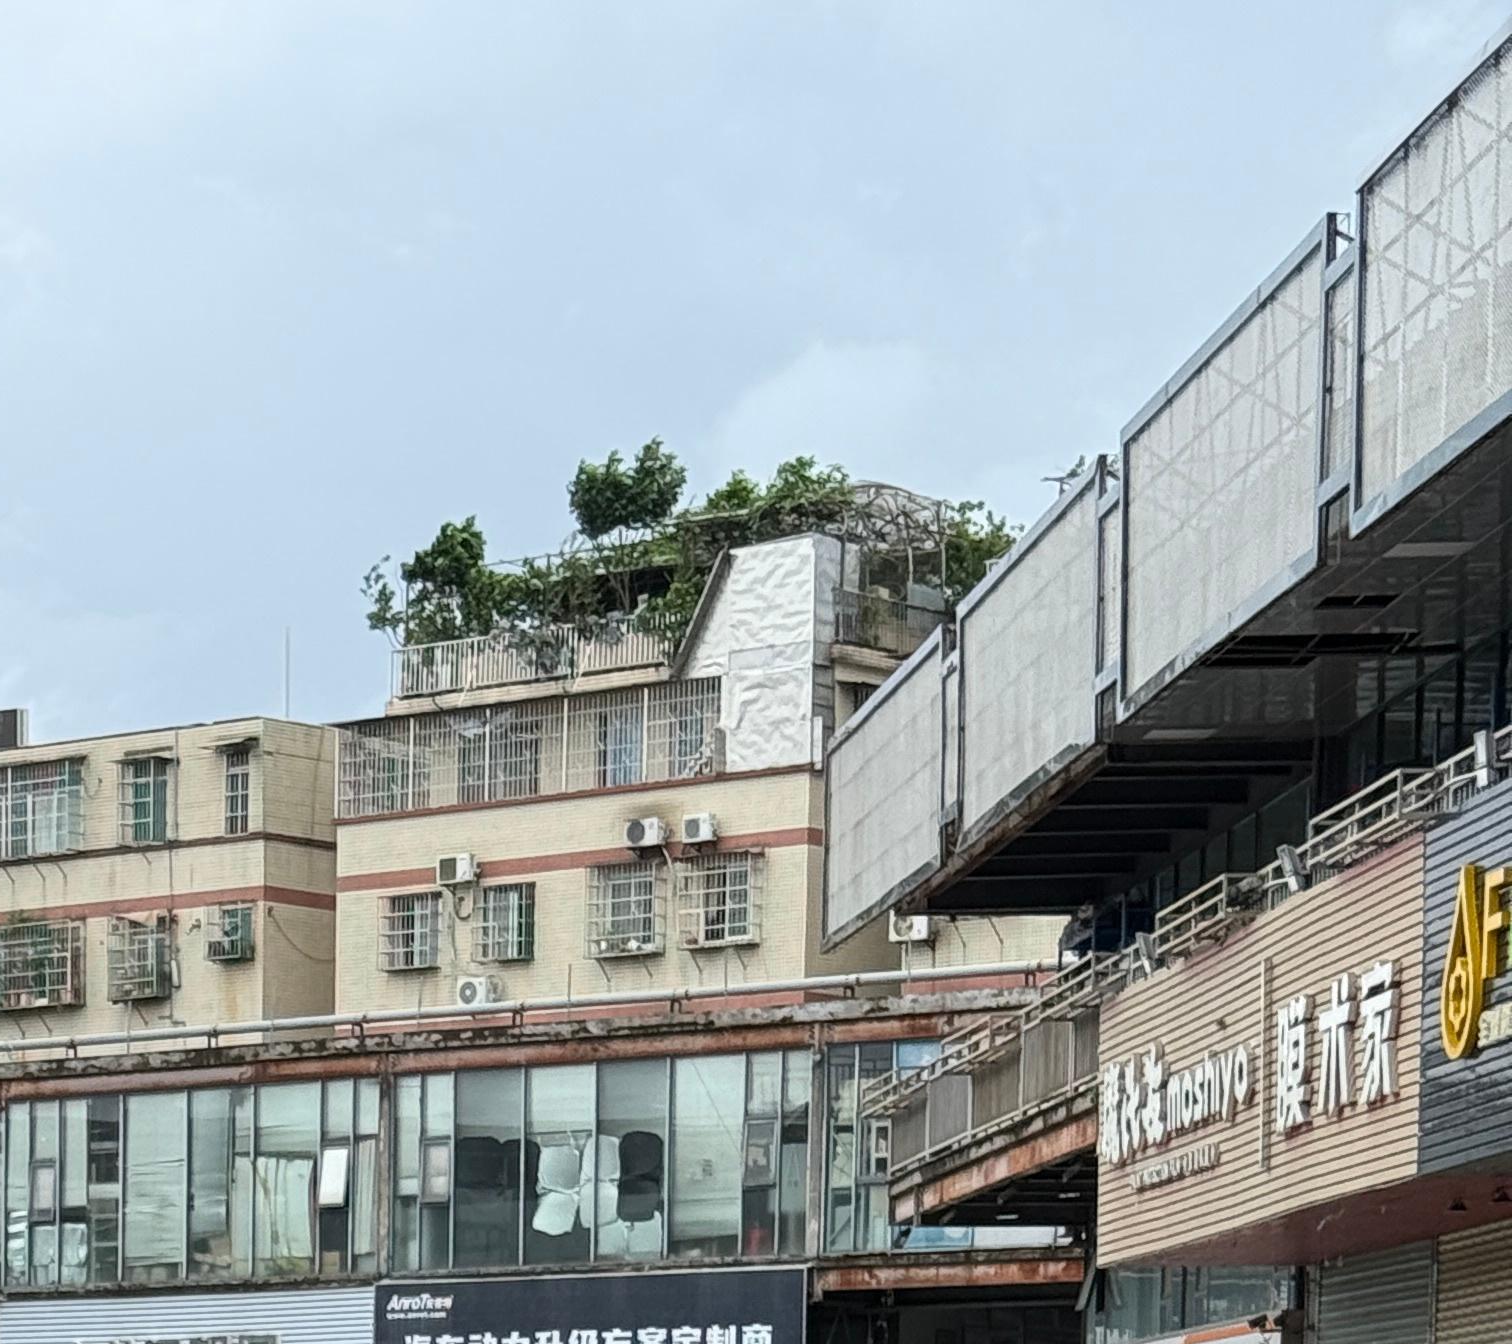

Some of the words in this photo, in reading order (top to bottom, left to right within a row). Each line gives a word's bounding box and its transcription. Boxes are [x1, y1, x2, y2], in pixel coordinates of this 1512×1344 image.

[1166, 1045, 1248, 1133] moshiyo
[1276, 960, 1396, 1136] 膜术家
